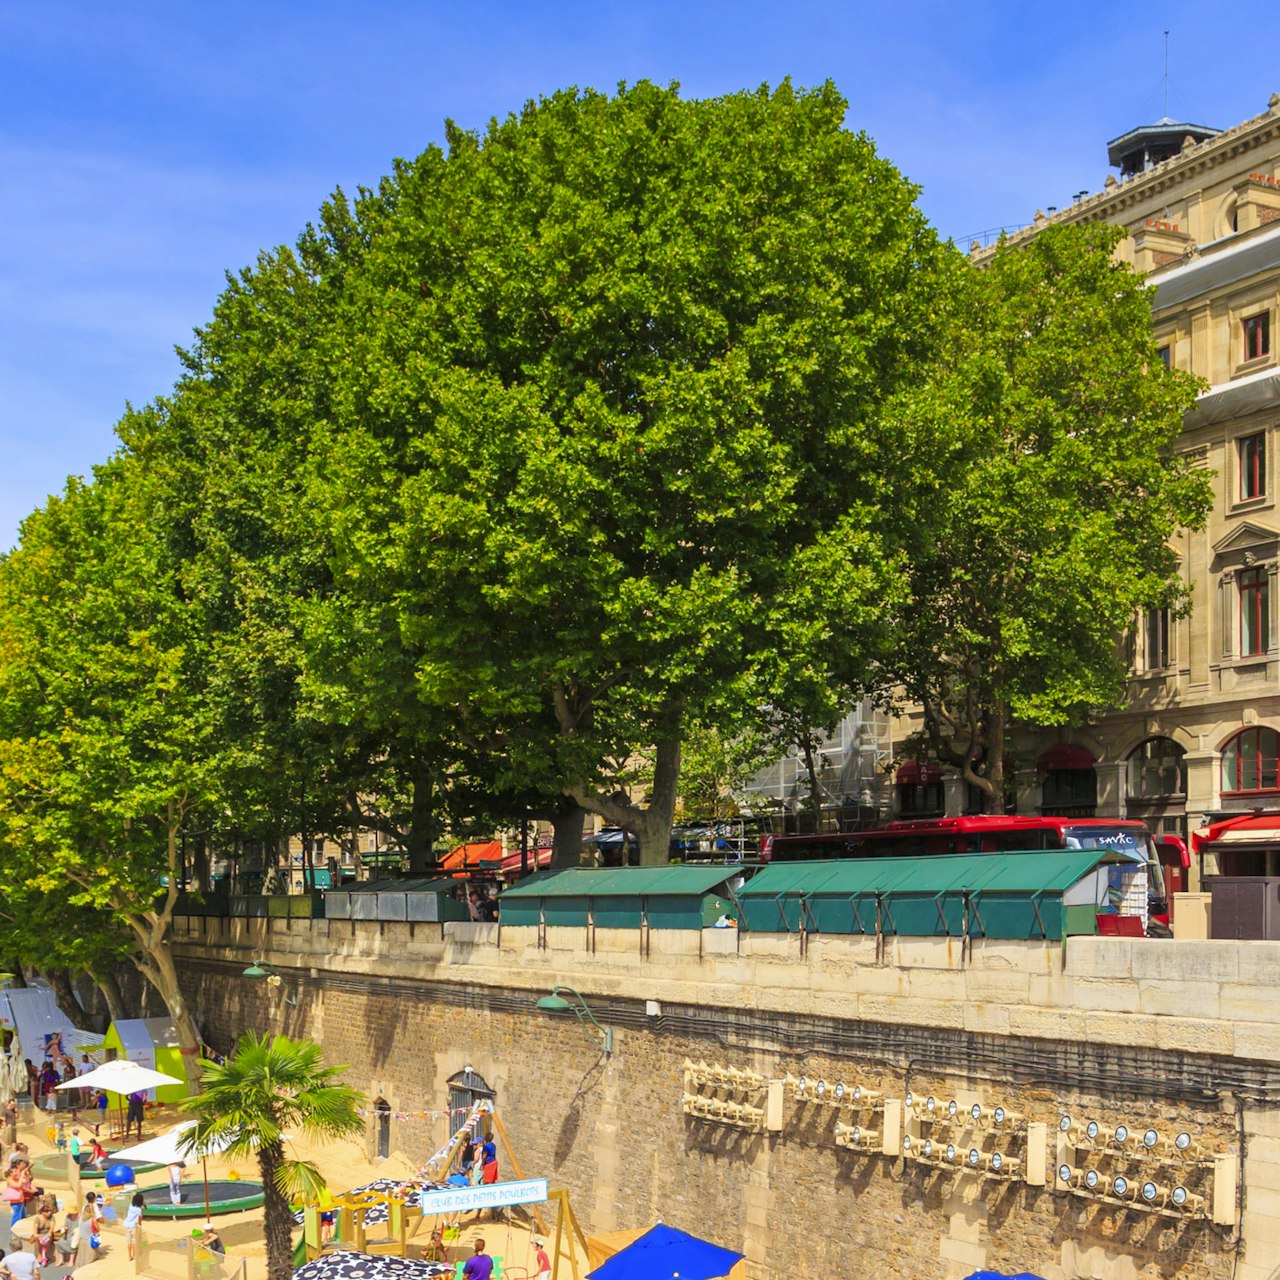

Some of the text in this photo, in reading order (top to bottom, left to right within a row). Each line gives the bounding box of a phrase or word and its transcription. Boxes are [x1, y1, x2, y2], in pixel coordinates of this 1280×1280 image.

[1099, 832, 1133, 844] SAVAC
[431, 1196, 452, 1208] CLUB
[455, 1194, 471, 1205] DES
[473, 1191, 497, 1203] PETITS
